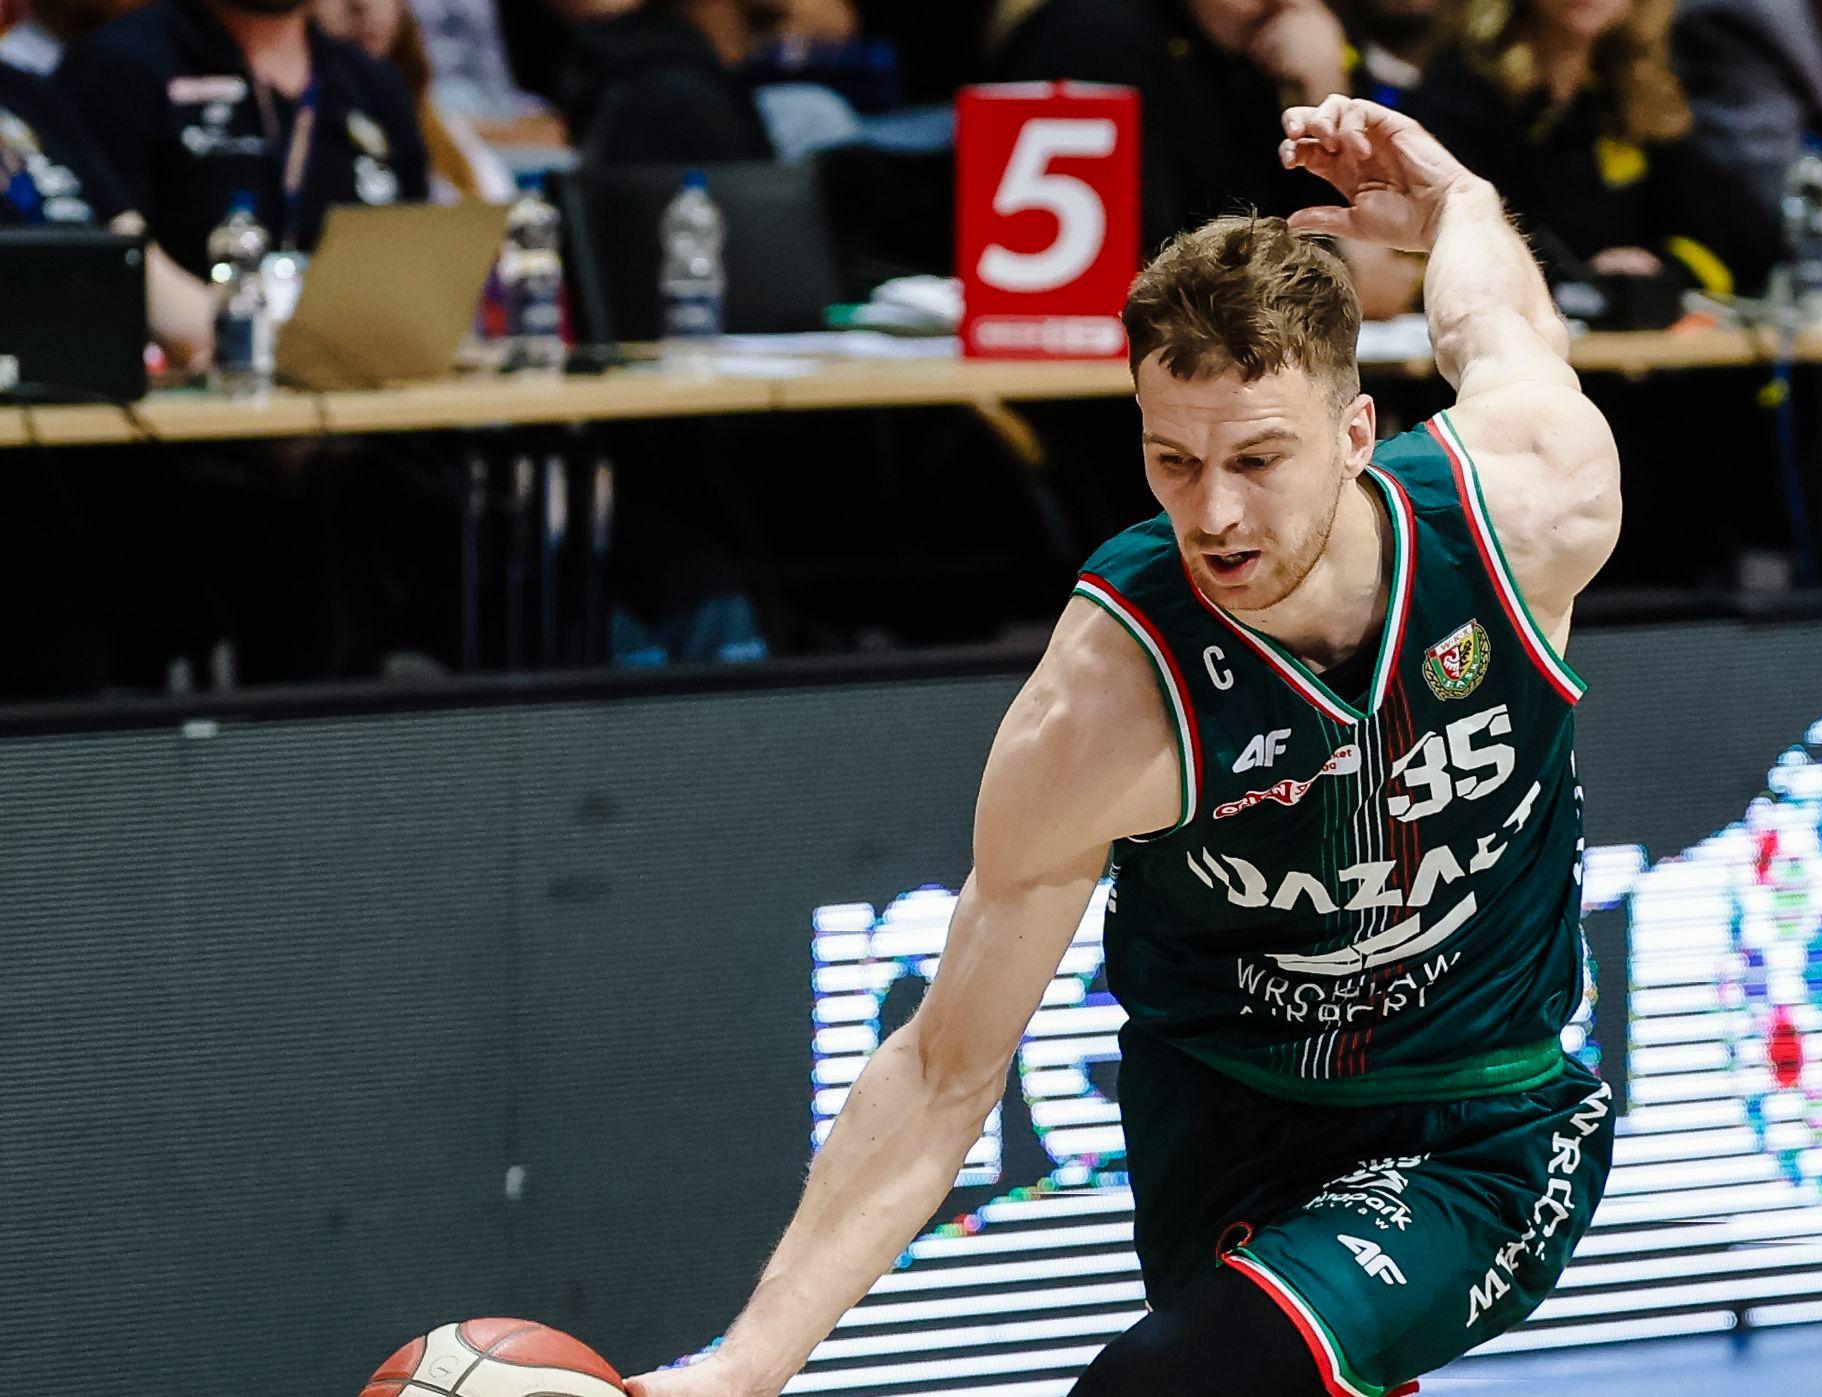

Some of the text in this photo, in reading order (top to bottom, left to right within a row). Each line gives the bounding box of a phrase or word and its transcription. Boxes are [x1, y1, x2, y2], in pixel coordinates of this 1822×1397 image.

[977, 117, 1119, 294] 5
[1204, 645, 1235, 691] C
[1388, 704, 1516, 823] 35
